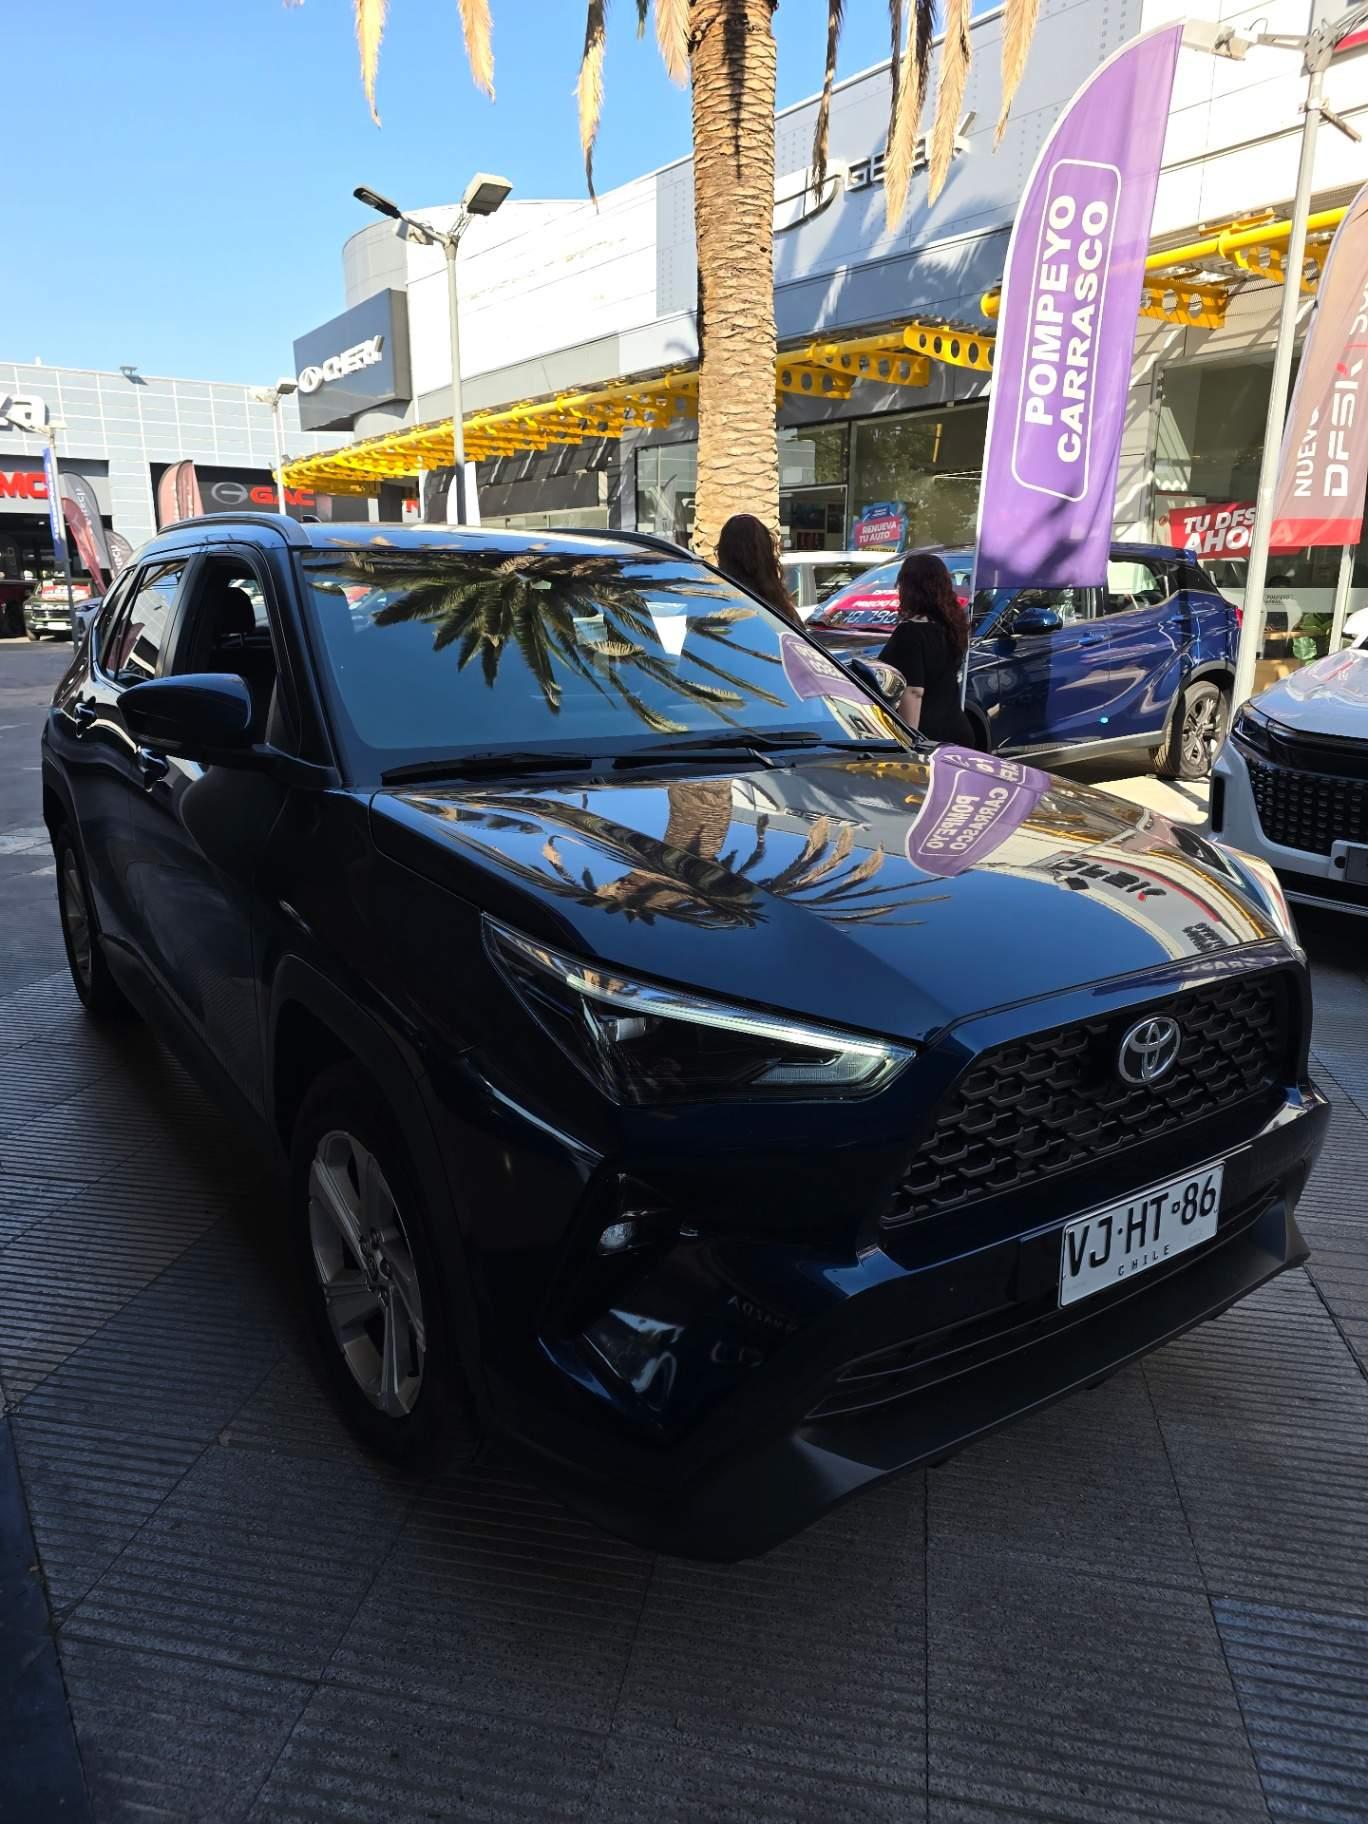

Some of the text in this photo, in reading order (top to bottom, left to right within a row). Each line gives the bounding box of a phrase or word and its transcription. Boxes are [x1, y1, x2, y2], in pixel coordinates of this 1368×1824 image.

[845, 111, 976, 191] GEY
[1024, 194, 1076, 426] POMPEYO
[1057, 200, 1109, 463] CARRASCO
[322, 335, 384, 381] CHERY
[251, 486, 315, 507] GAC
[859, 530, 890, 544] TU AUTO
[862, 521, 897, 534] RENUEVA
[1183, 514, 1211, 535] TU
[1118, 1244, 1171, 1277] CHILE
